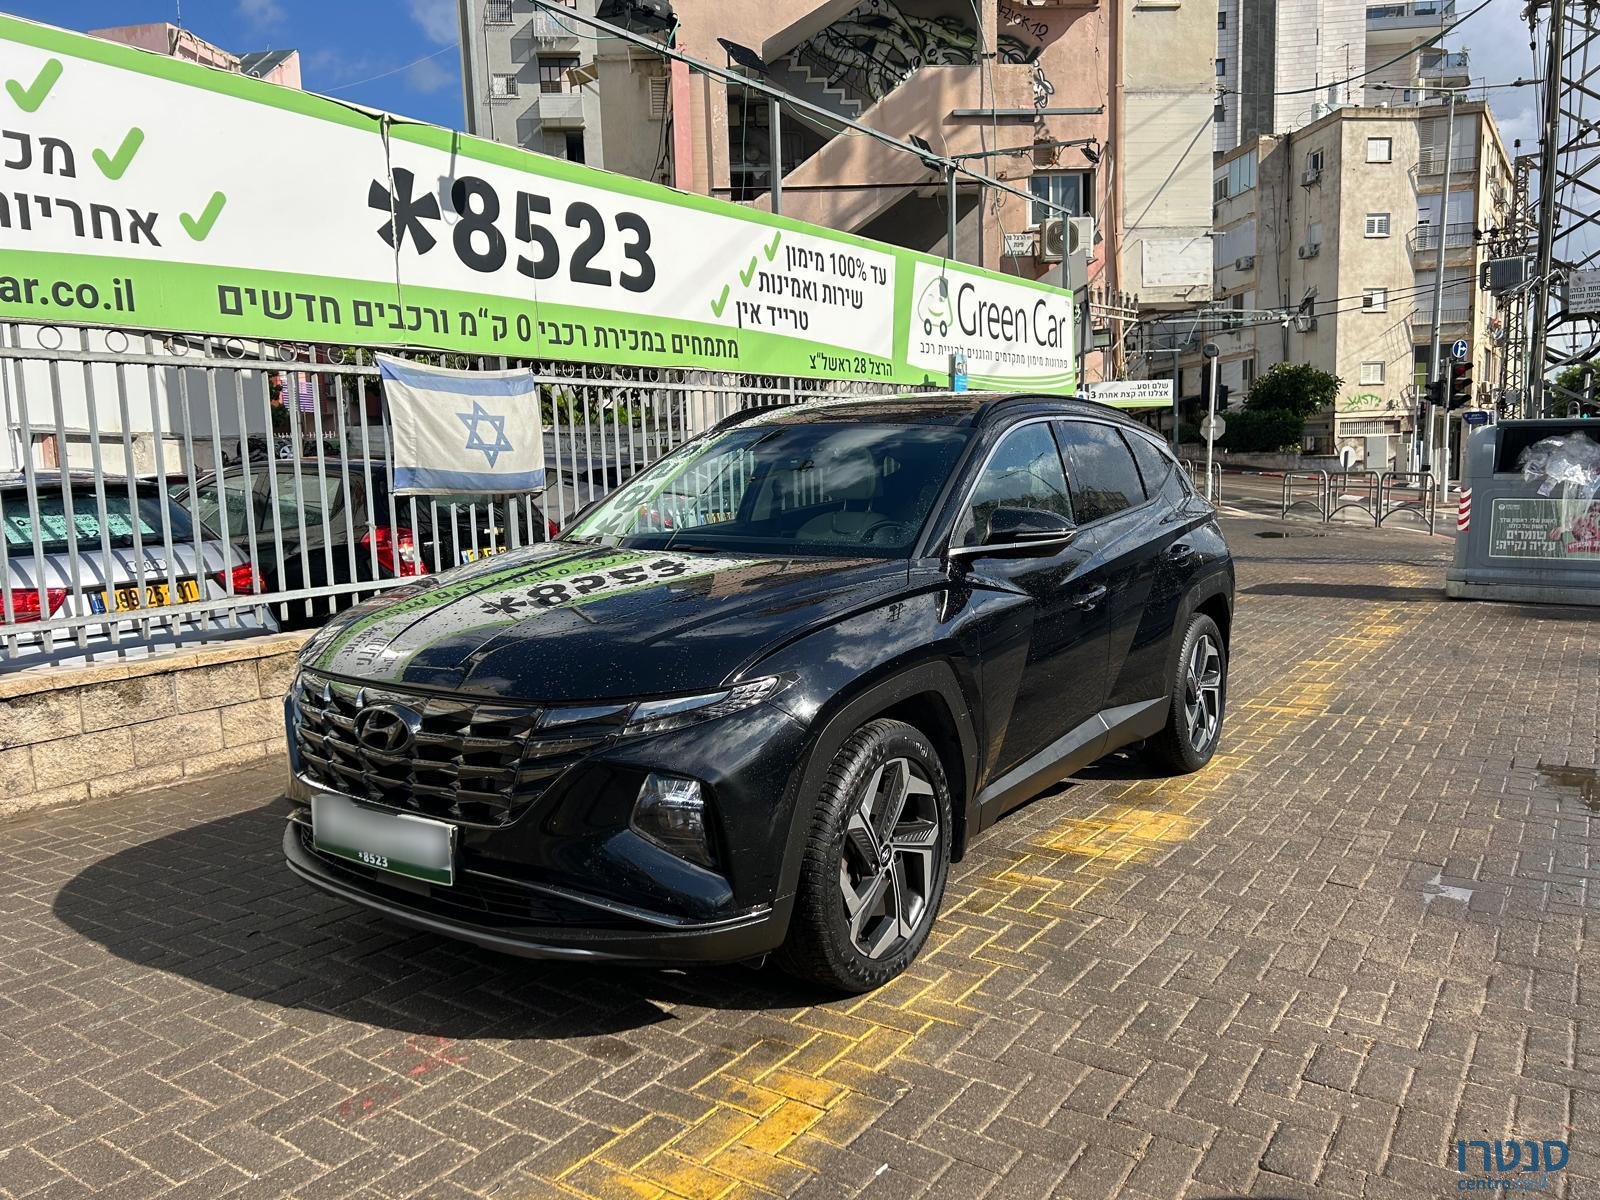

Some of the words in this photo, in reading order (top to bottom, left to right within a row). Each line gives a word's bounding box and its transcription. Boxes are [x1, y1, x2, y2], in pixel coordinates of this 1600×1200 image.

[785, 244, 825, 272] מימון
[829, 252, 867, 282] 100%
[758, 271, 818, 302] ואמינות
[870, 264, 887, 286] עד
[217, 284, 341, 325] חדשים
[822, 283, 863, 310] שירות
[352, 299, 449, 334] ורכבים
[516, 313, 531, 342] 0
[735, 300, 762, 329] אין
[766, 304, 809, 331] טרייד
[957, 281, 1028, 344] Green
[1032, 298, 1066, 349] Car
[537, 320, 588, 346] רכבי
[594, 325, 667, 353] במכירת
[671, 333, 739, 359] מתמחים
[920, 341, 936, 355] רכב
[967, 347, 993, 362] והוגנים
[995, 352, 1026, 367] מתקדמים
[1026, 354, 1044, 368] מימון
[853, 357, 867, 375] 28
[868, 357, 893, 377] הרצל
[1044, 357, 1068, 369] פתרונות
[1098, 391, 1119, 399] אחרת
[1120, 390, 1136, 399] קצת
[1148, 389, 1169, 397] אצלנו
[1152, 381, 1169, 389] שלם
